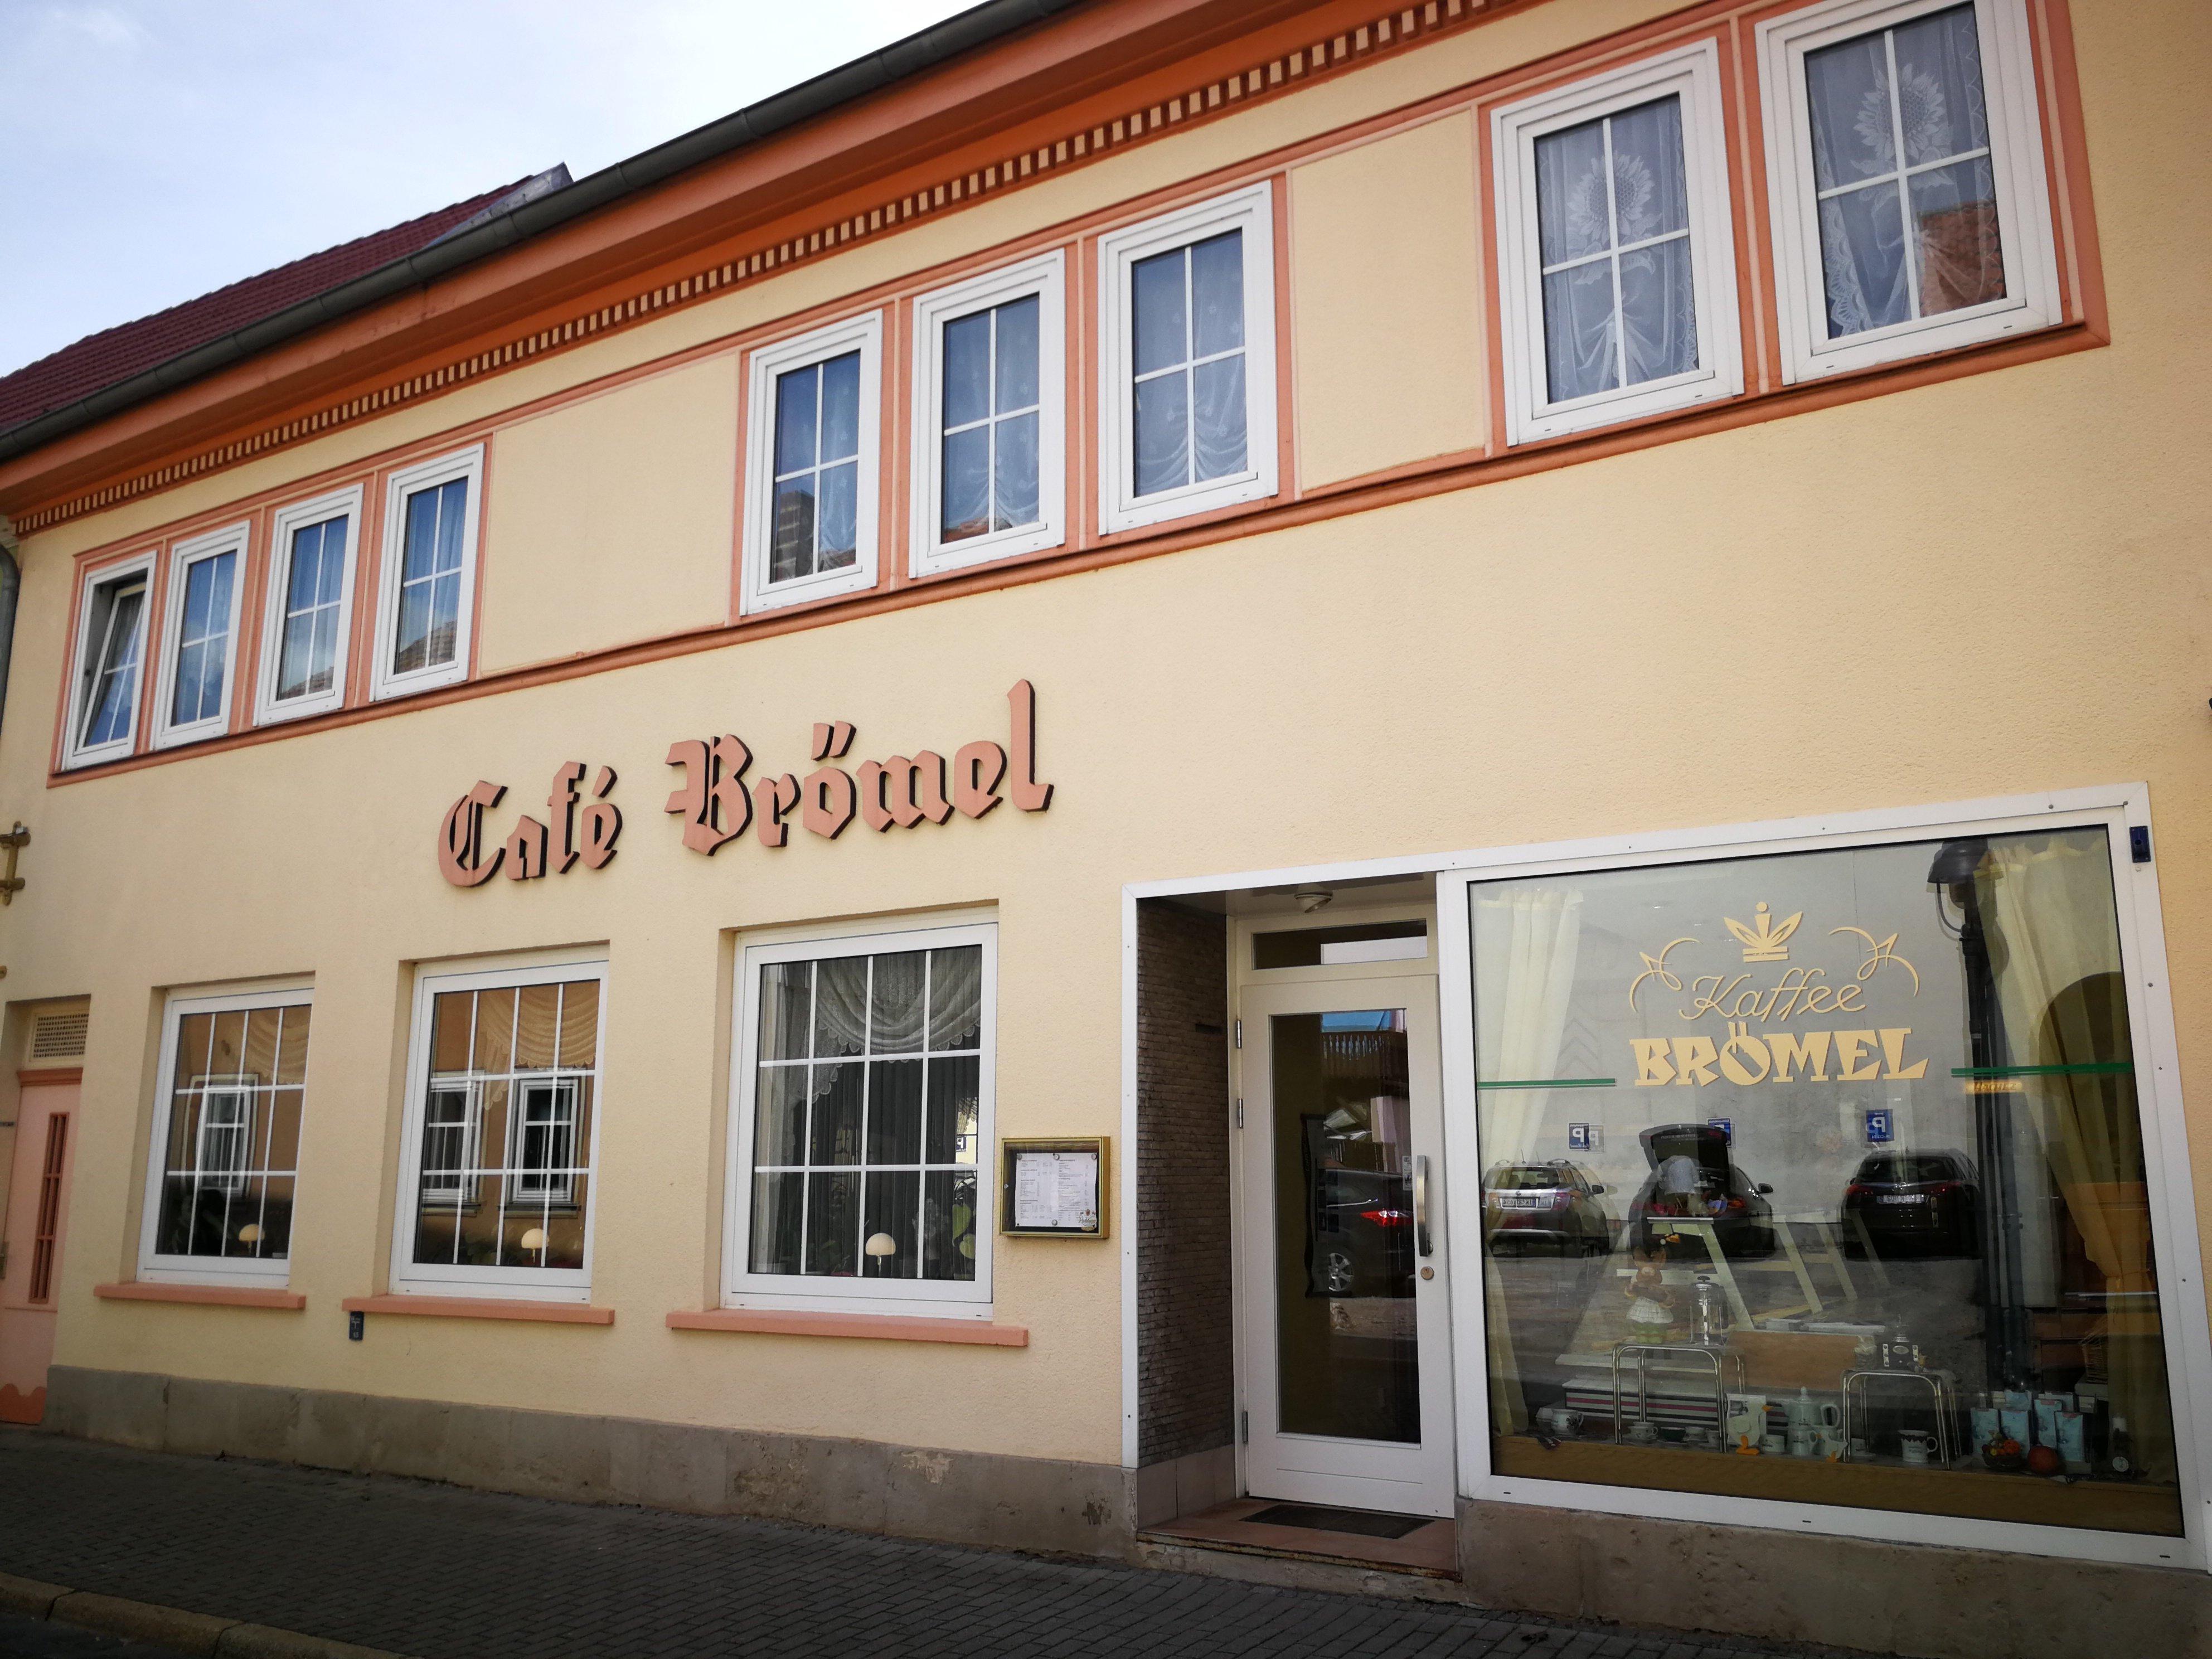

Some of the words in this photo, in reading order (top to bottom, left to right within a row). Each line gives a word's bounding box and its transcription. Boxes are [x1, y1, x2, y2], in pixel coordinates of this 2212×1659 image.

[438, 761, 622, 887] Café
[664, 678, 1054, 856] Brömel
[1679, 968, 1866, 1022] Kaffee
[1629, 1021, 1928, 1086] BRÖMEL
